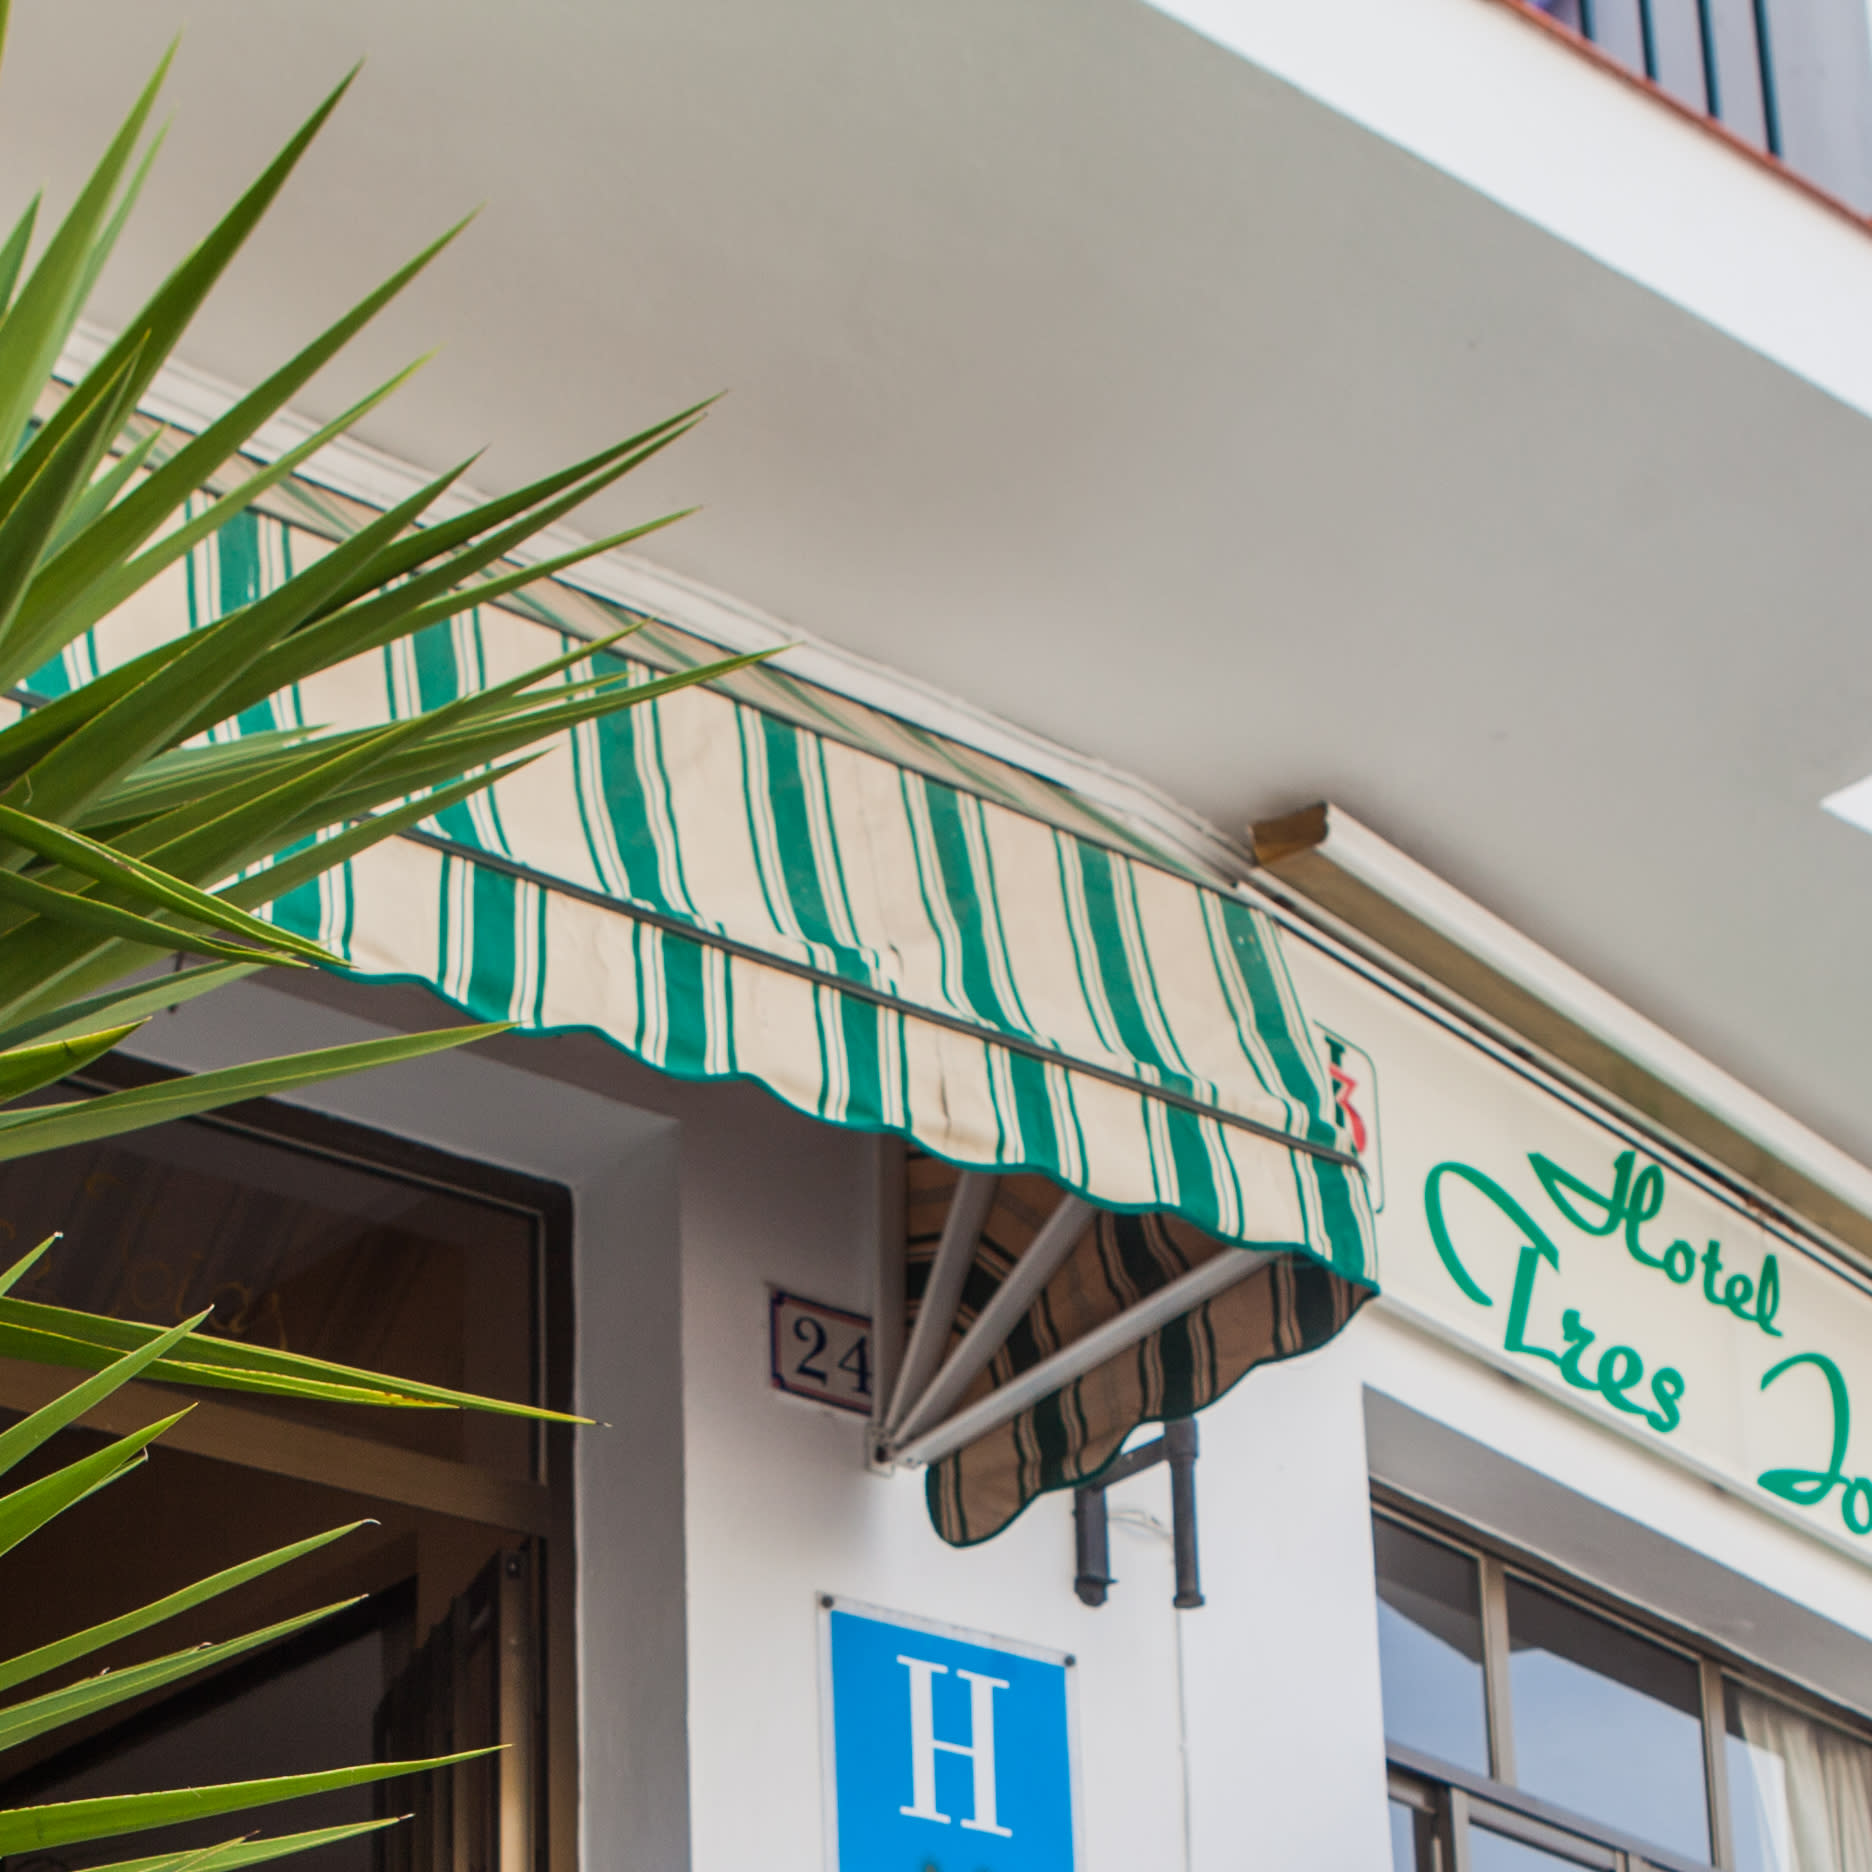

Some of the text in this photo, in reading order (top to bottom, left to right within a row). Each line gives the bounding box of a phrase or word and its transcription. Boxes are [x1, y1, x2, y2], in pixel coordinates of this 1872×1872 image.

[1422, 1160, 1685, 1433] Tres
[1527, 1150, 1784, 1338] Hotel
[793, 1315, 872, 1396] 24
[896, 1653, 1012, 1838] H
